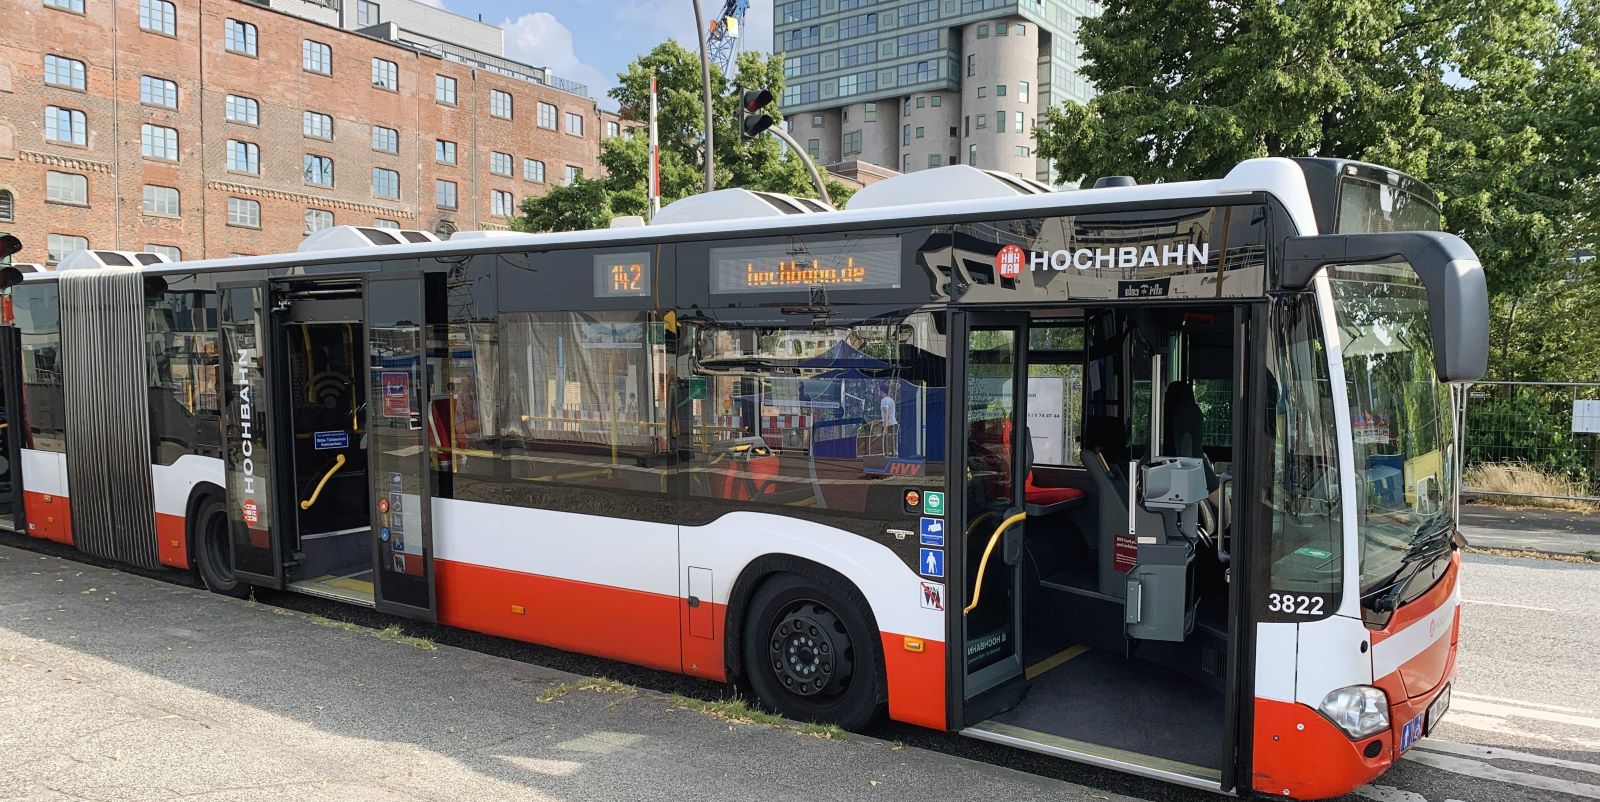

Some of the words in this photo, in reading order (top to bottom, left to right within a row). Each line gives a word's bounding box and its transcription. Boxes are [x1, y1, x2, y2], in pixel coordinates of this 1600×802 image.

[1030, 243, 1209, 271] HOCHBAHN
[611, 264, 641, 291] 142
[747, 257, 865, 286] hochbahn.de
[238, 349, 255, 494] HOCHBAHN
[890, 462, 921, 476] HVV
[1268, 593, 1325, 615] 3822
